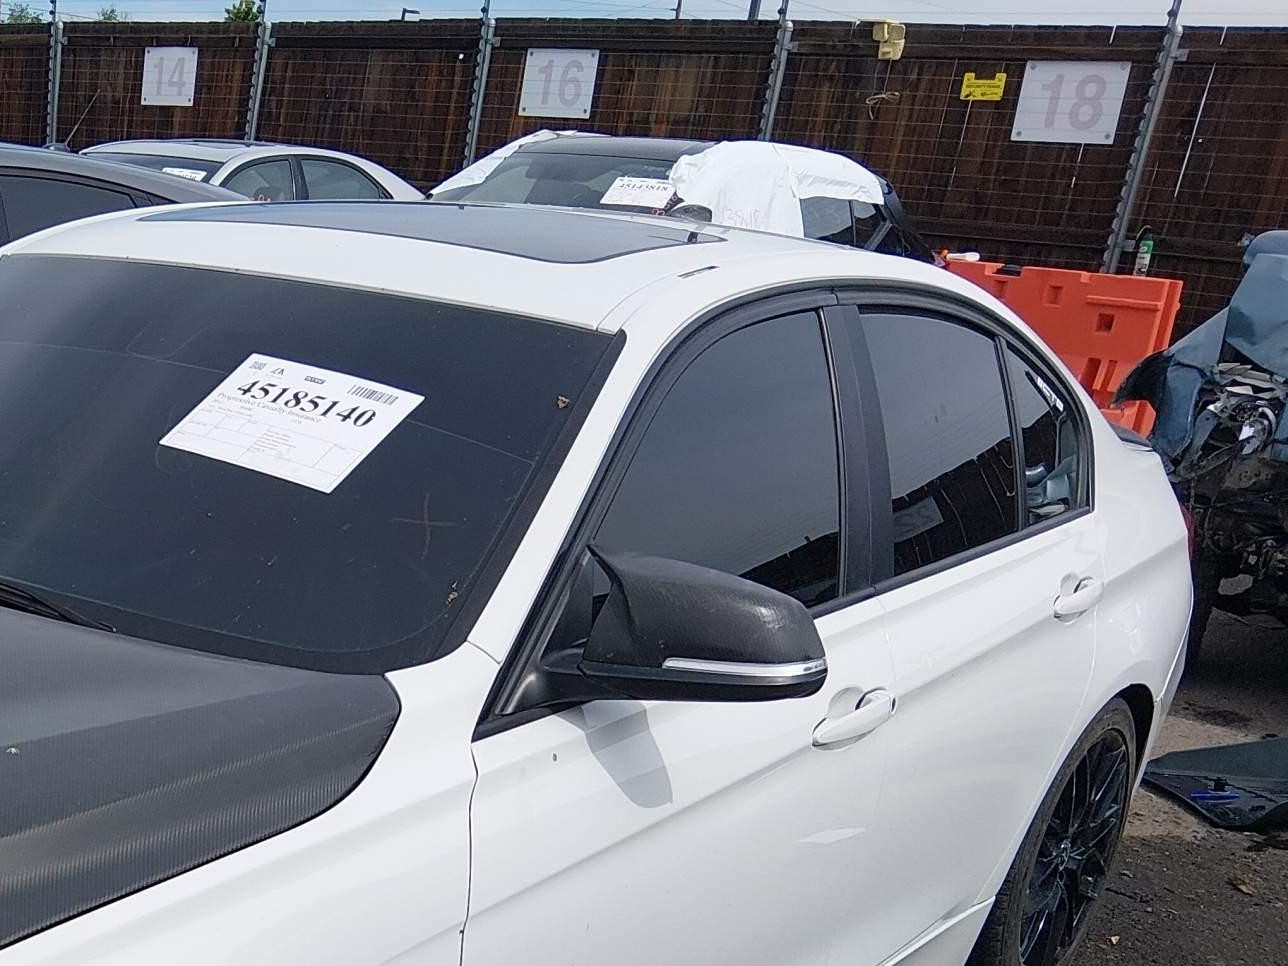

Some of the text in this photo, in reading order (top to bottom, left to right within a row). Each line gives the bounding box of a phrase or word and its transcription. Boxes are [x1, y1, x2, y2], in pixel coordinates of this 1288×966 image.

[153, 56, 186, 97] 14
[538, 59, 584, 107] 16
[1042, 73, 1107, 130] 18
[237, 380, 377, 427] 45185140
